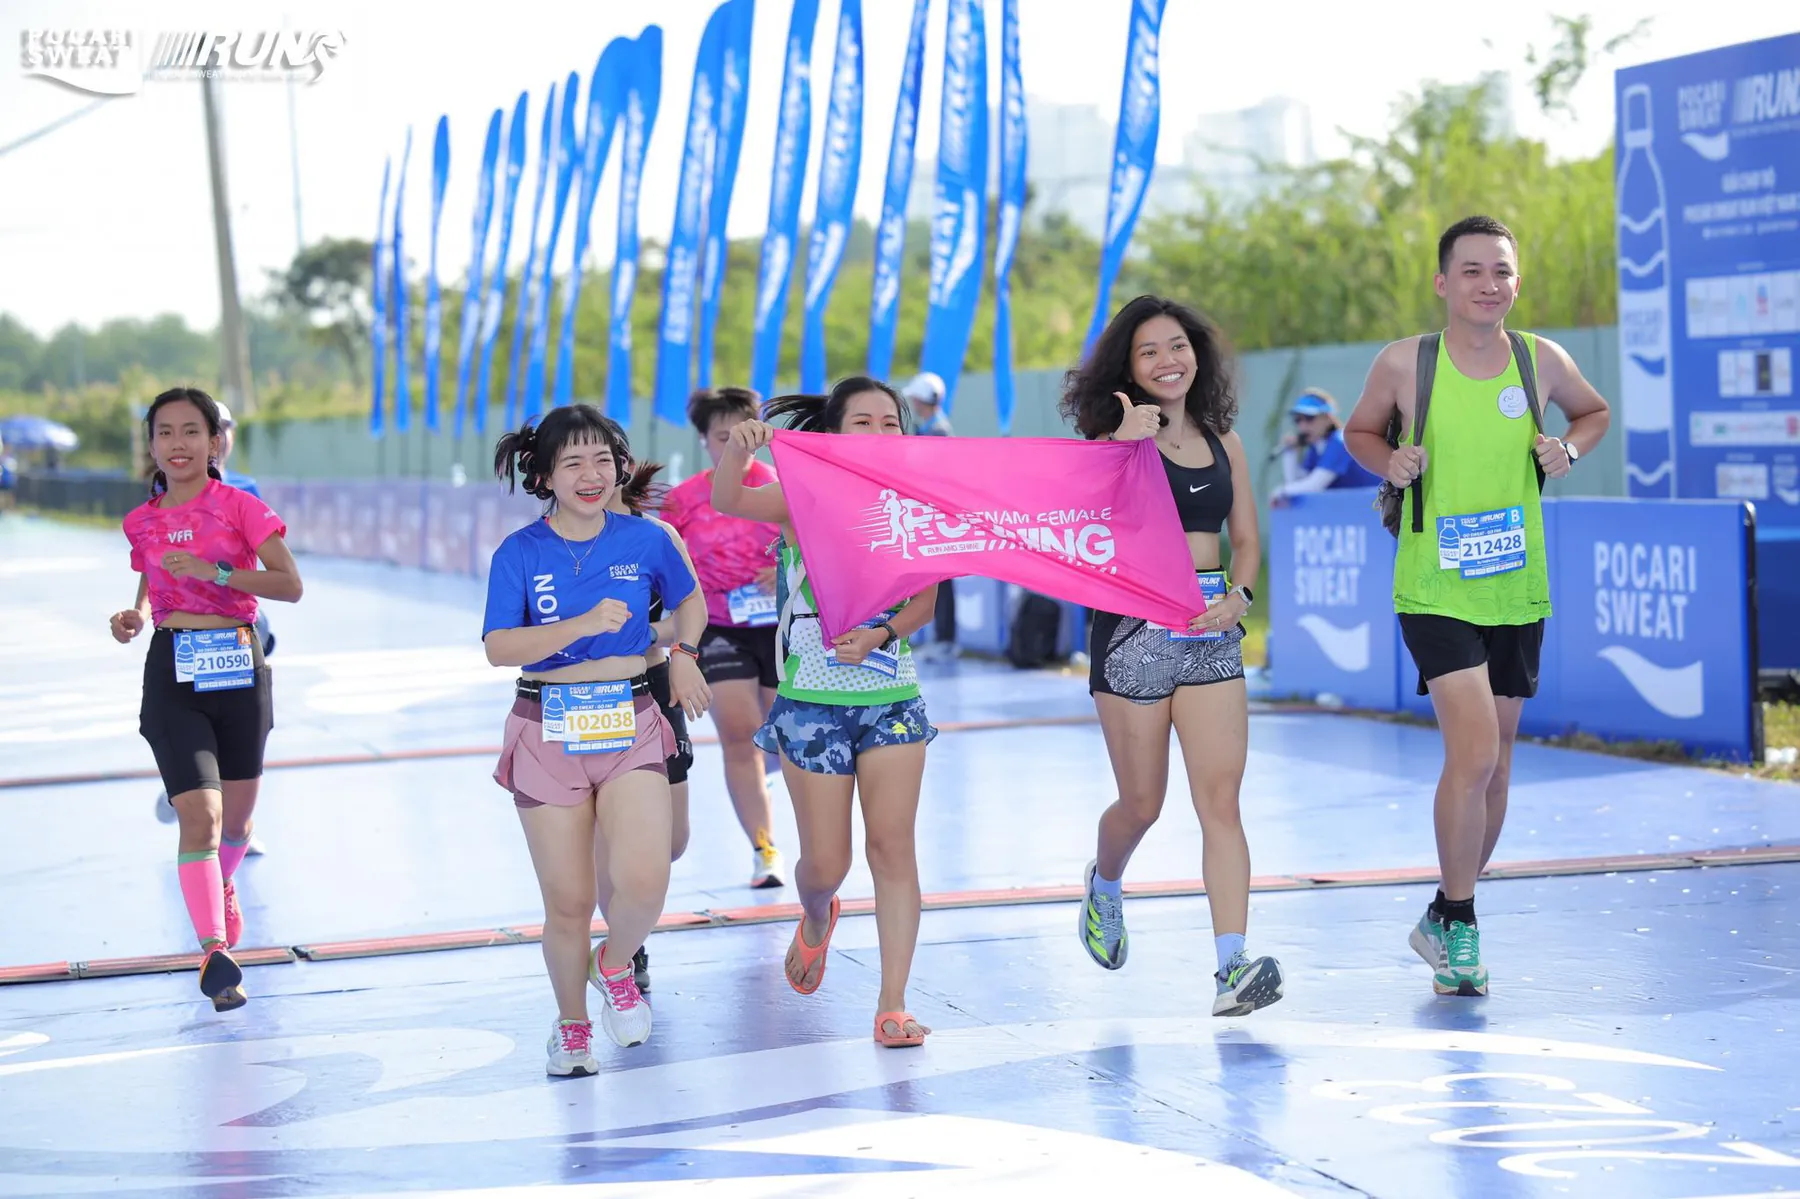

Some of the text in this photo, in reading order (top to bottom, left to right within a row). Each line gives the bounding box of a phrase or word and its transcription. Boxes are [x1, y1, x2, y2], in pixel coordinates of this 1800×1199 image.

[1511, 509, 1520, 523] B
[1294, 525, 1367, 565] POCARI
[1462, 534, 1522, 557] 212428
[609, 563, 639, 573] POCARI
[1594, 540, 1697, 593] POCARI
[1294, 566, 1360, 606] SWEAT
[1595, 587, 1688, 641] SWEAT
[197, 653, 250, 671] 210590
[566, 711, 633, 732] 102038
